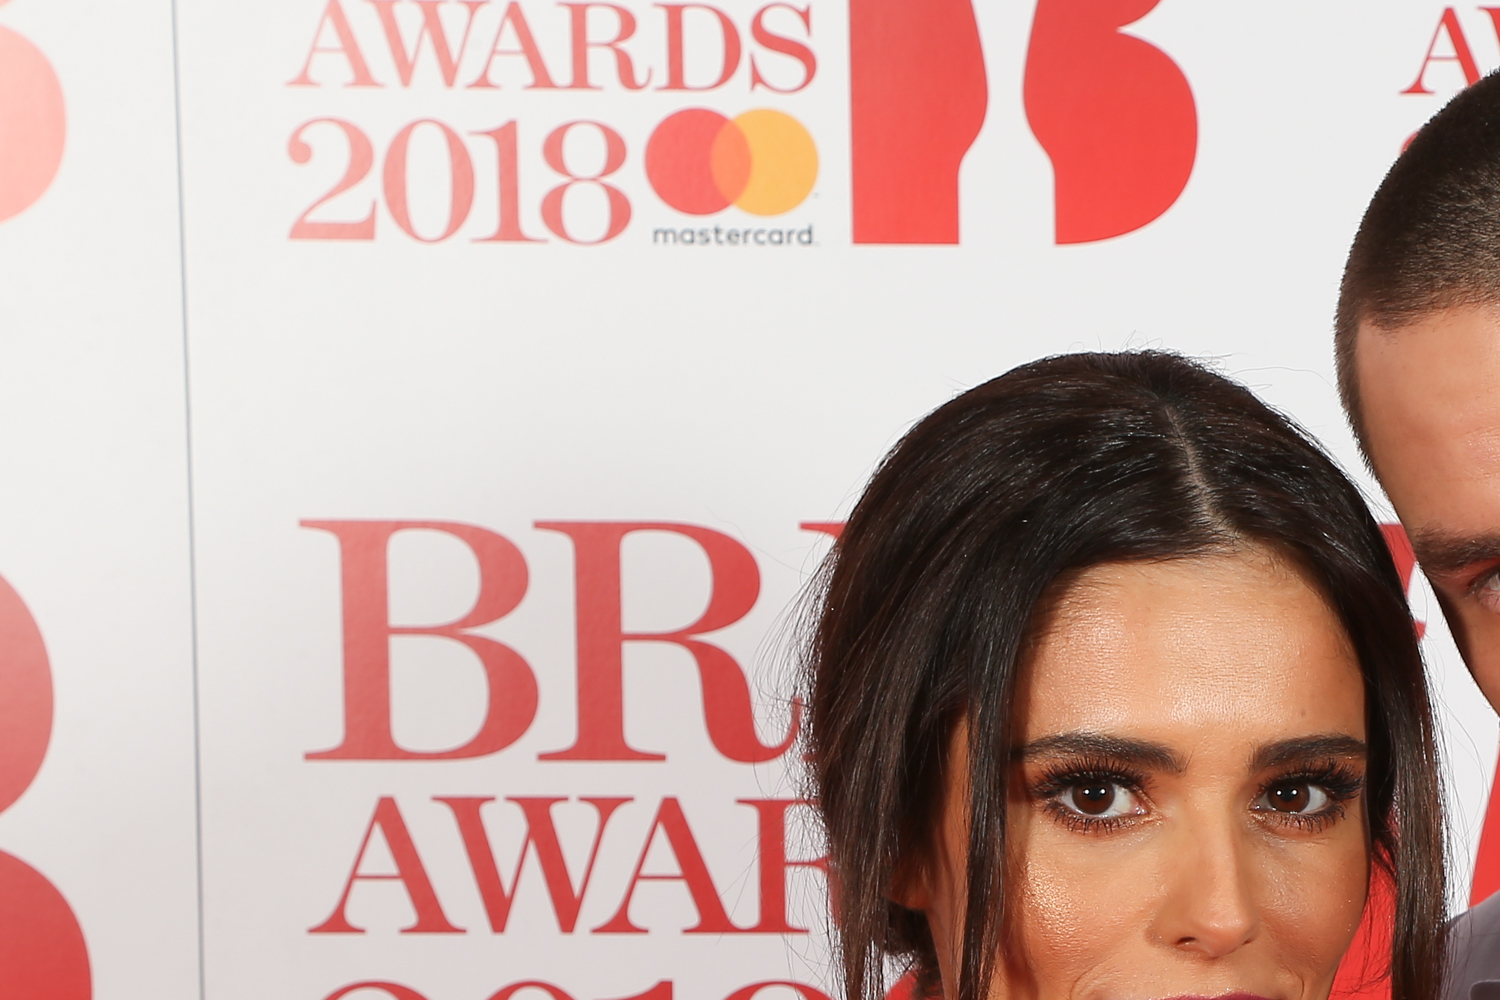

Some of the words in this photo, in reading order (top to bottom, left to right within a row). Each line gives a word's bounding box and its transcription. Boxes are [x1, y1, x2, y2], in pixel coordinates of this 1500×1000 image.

[285, 0, 817, 94] AWARDS
[287, 117, 632, 246] 2018
[298, 518, 848, 764] BR
